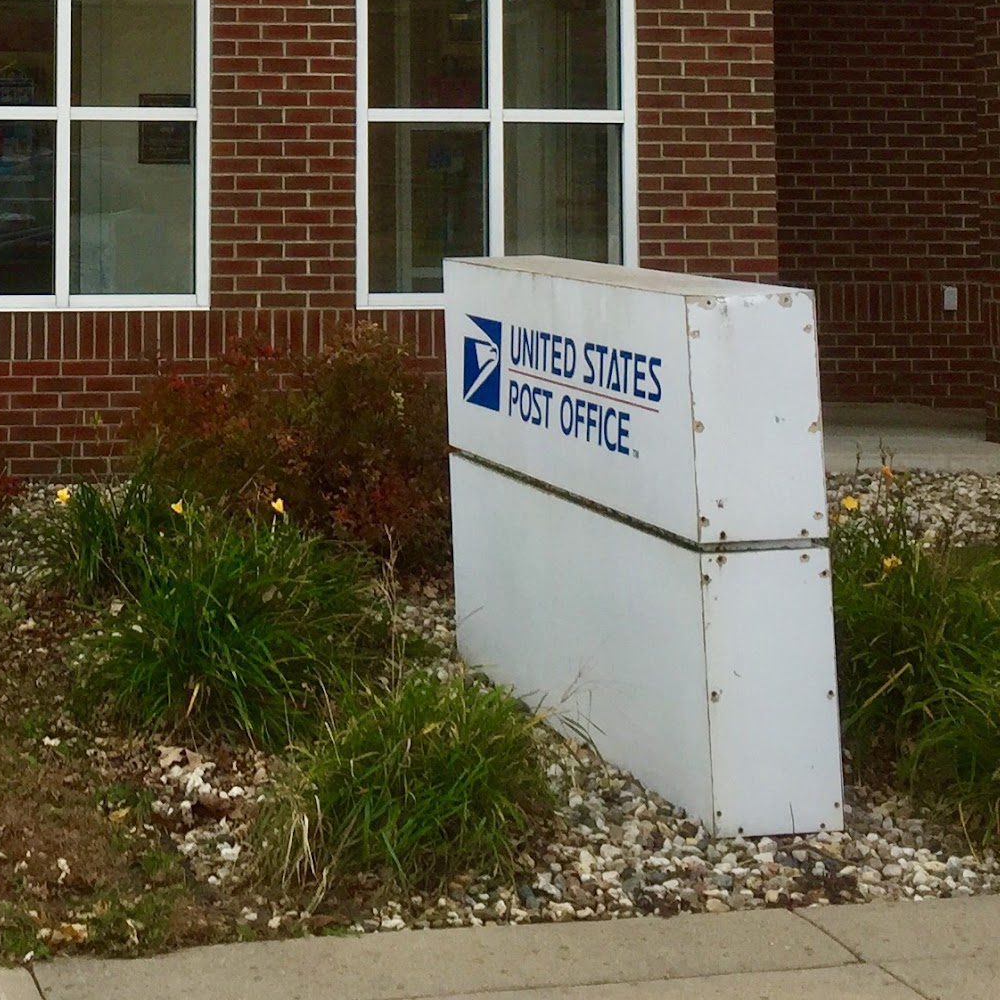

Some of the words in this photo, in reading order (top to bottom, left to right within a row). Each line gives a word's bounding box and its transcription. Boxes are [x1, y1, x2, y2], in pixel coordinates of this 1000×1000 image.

[510, 325, 576, 378] UNITED
[583, 342, 662, 402] STATES
[508, 380, 553, 429] POST
[560, 395, 630, 456] OFFICE
